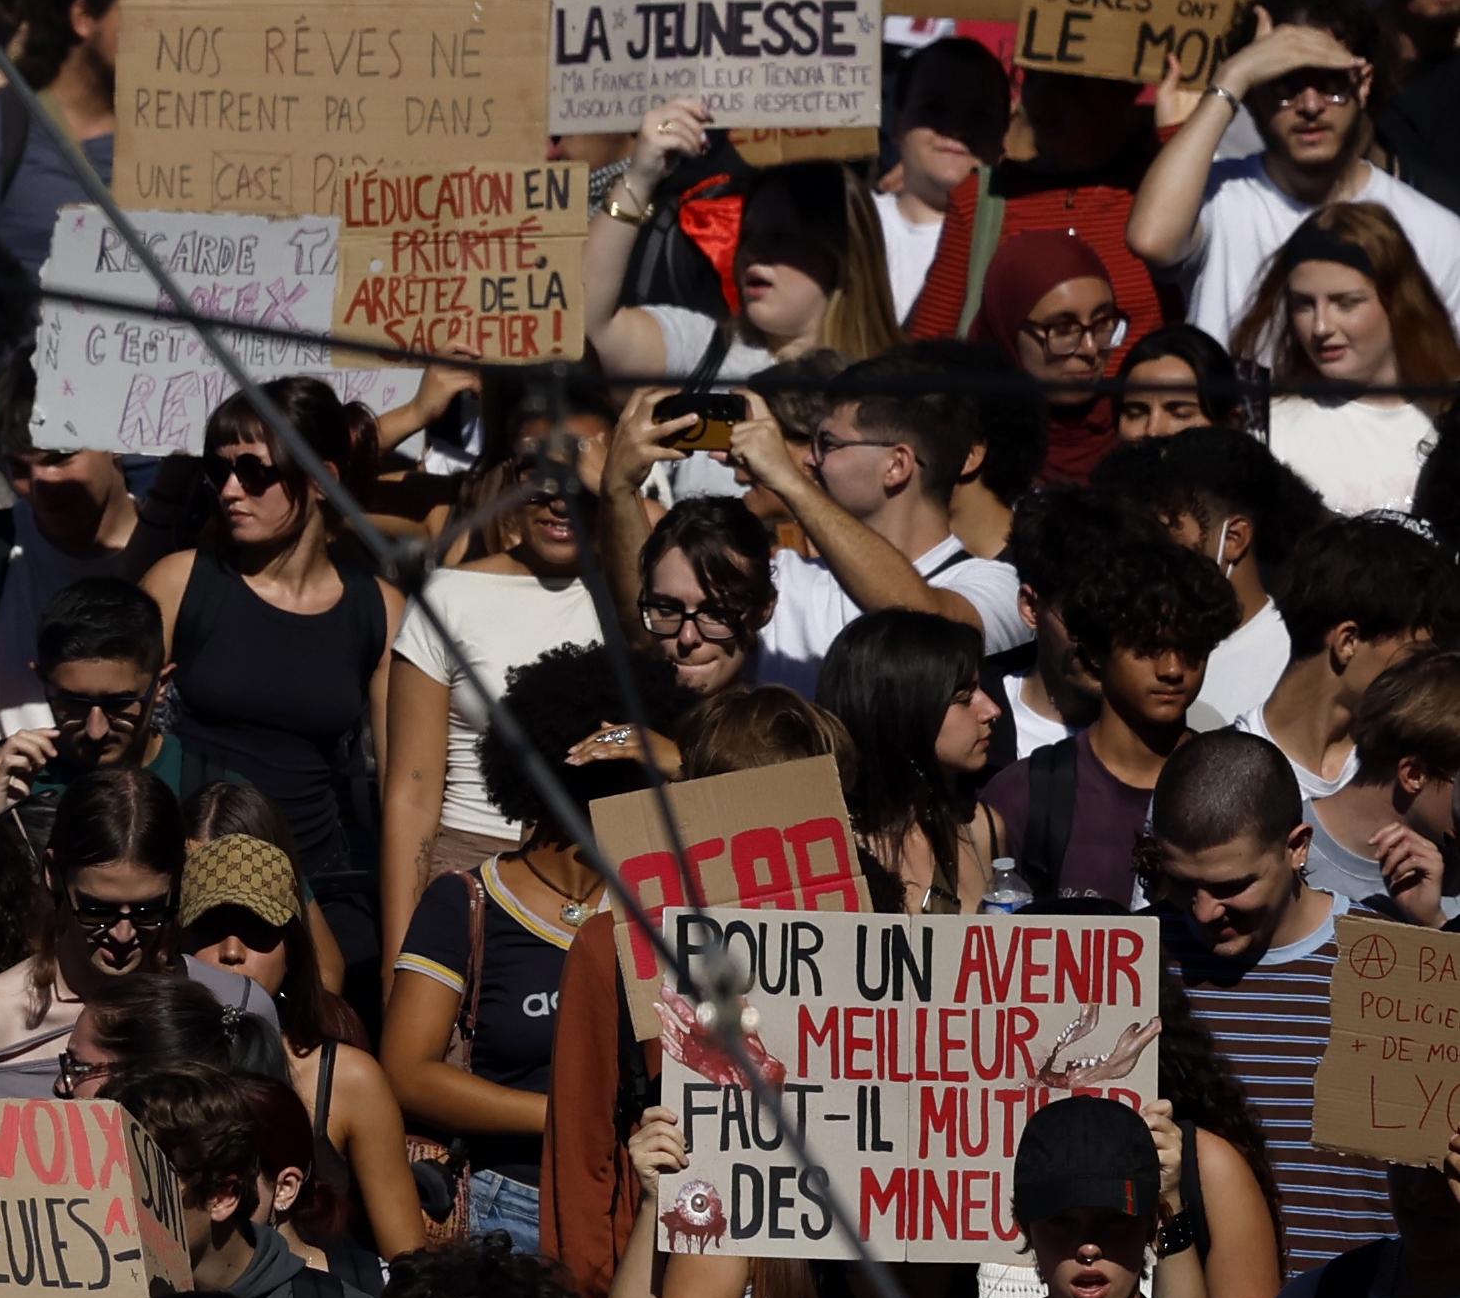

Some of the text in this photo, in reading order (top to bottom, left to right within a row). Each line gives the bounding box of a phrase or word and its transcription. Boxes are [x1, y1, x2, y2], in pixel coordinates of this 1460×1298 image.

[157, 14, 486, 78] NOS RÊVES NE
[556, 0, 858, 66] LA JEUNESSE
[1023, 7, 1087, 64] LE
[134, 88, 493, 139] RENTRENT PAS DANS
[753, 89, 867, 113] RESPECTENT
[136, 162, 283, 202] UNE CASE
[345, 166, 571, 227] L'ÉDUCATION EN
[344, 271, 567, 323] ARRÊTEZ DE LA
[854, 923, 1144, 1010] UN AVENIR
[796, 1004, 1040, 1085] MEILLEUR
[730, 1162, 833, 1240] DES
